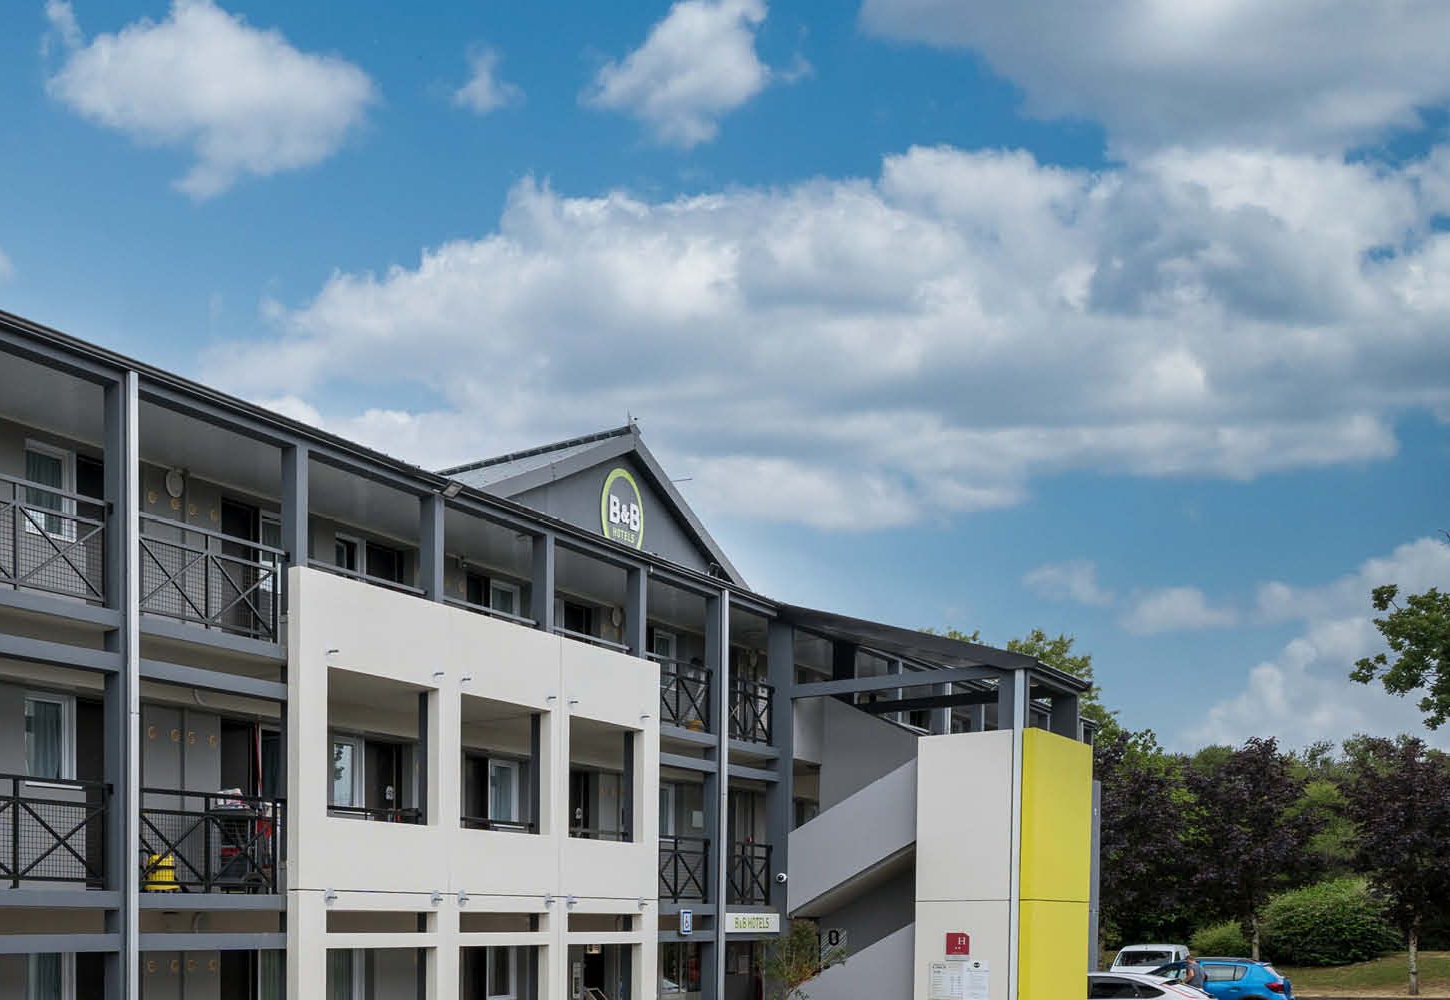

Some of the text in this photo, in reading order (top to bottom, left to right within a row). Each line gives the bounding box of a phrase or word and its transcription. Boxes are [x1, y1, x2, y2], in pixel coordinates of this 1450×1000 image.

[609, 494, 640, 532] B&B
[612, 526, 636, 544] HOTELS
[748, 917, 770, 929] HOTELS
